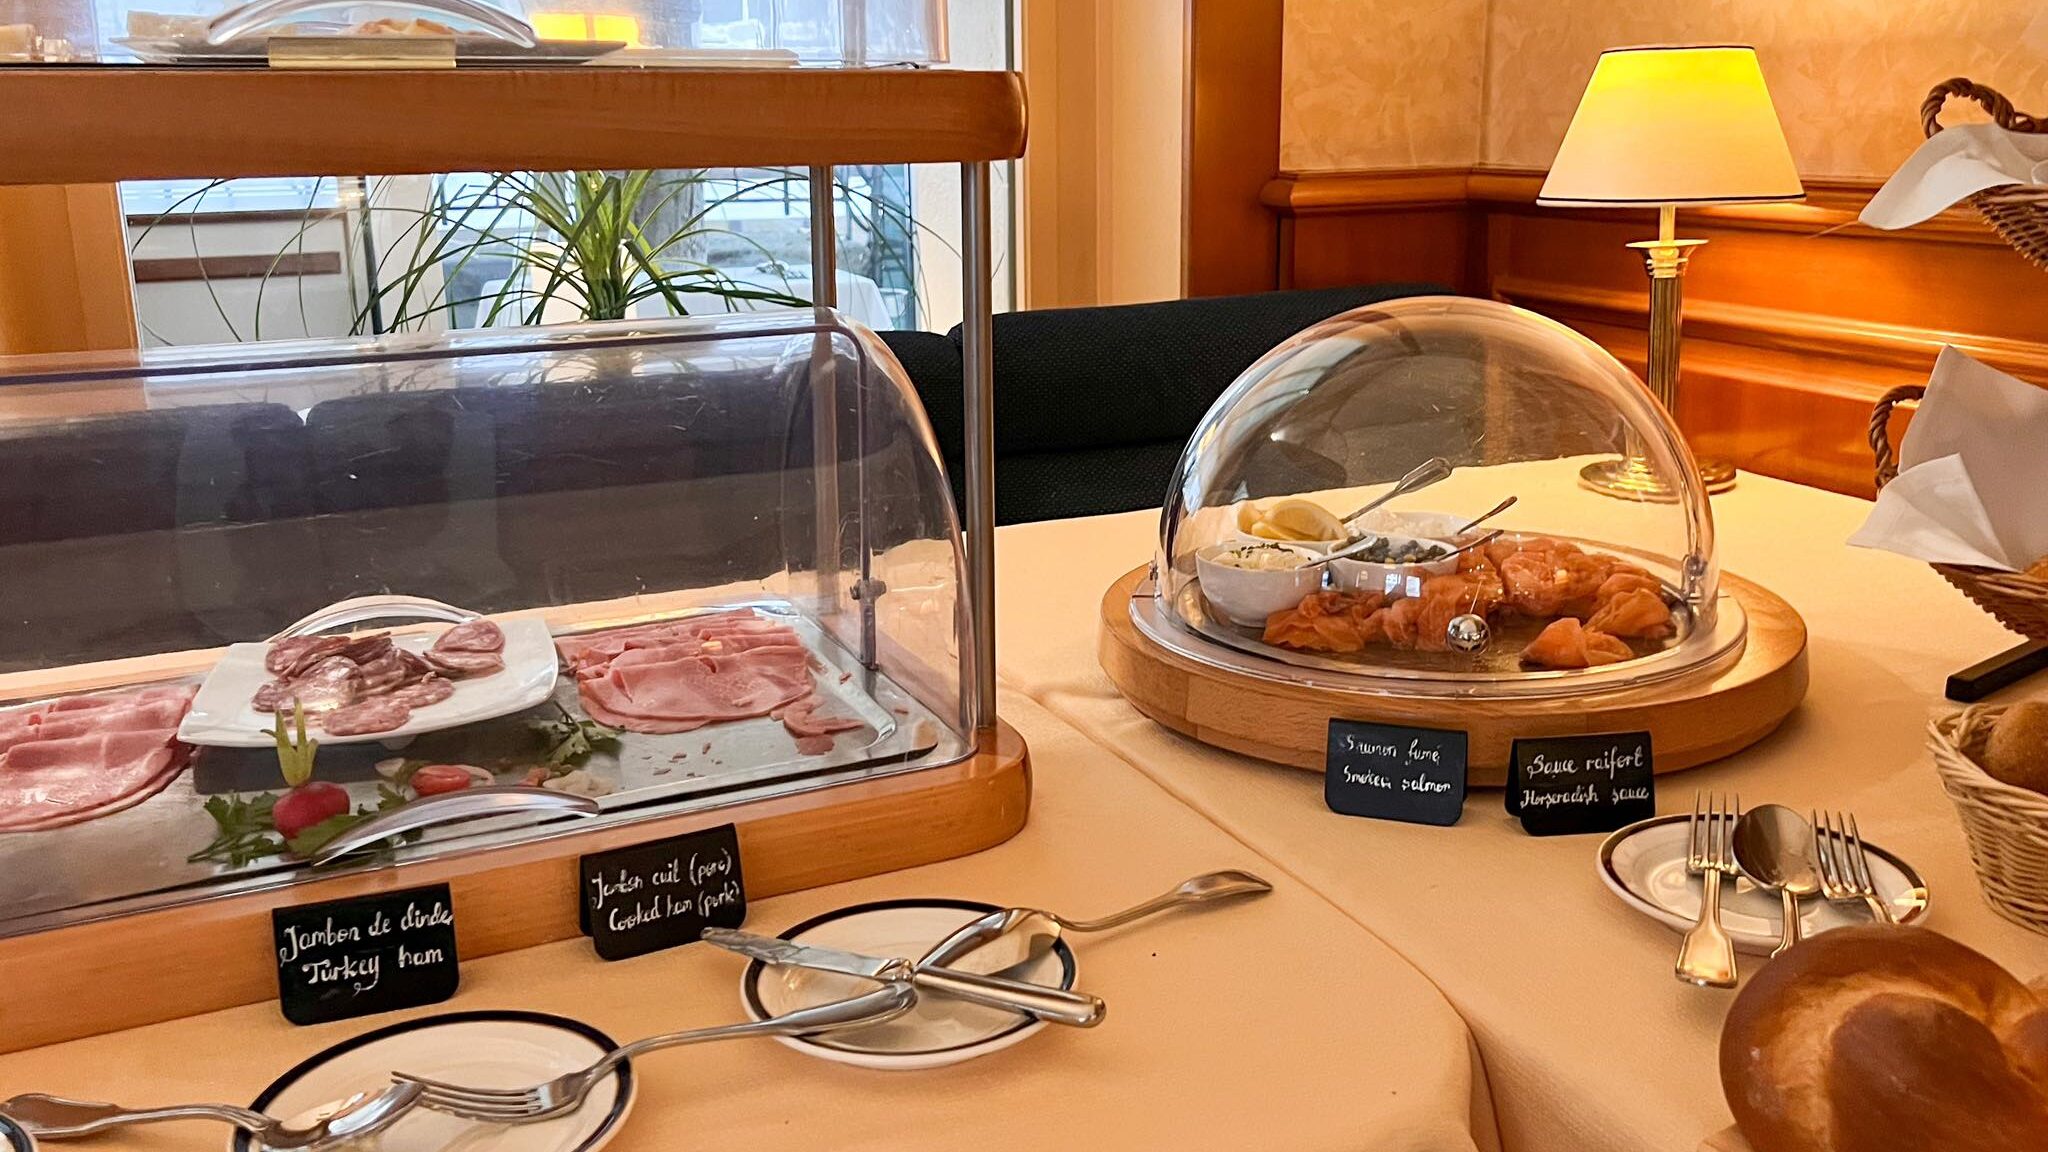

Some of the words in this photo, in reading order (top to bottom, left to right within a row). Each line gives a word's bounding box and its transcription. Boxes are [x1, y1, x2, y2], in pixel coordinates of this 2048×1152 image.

[1402, 772, 1451, 793] salmon
[1527, 754, 1578, 779] Sauce
[1586, 745, 1643, 780] raifort
[1520, 783, 1599, 809] Horseradish
[1612, 787, 1650, 805] sauce
[608, 894, 662, 931] Cooked
[666, 894, 693, 918] ham
[697, 880, 740, 918] (pork)
[279, 916, 361, 968] Jambon
[368, 911, 392, 937] de
[301, 955, 380, 997] Turkey
[398, 944, 444, 968] ham
